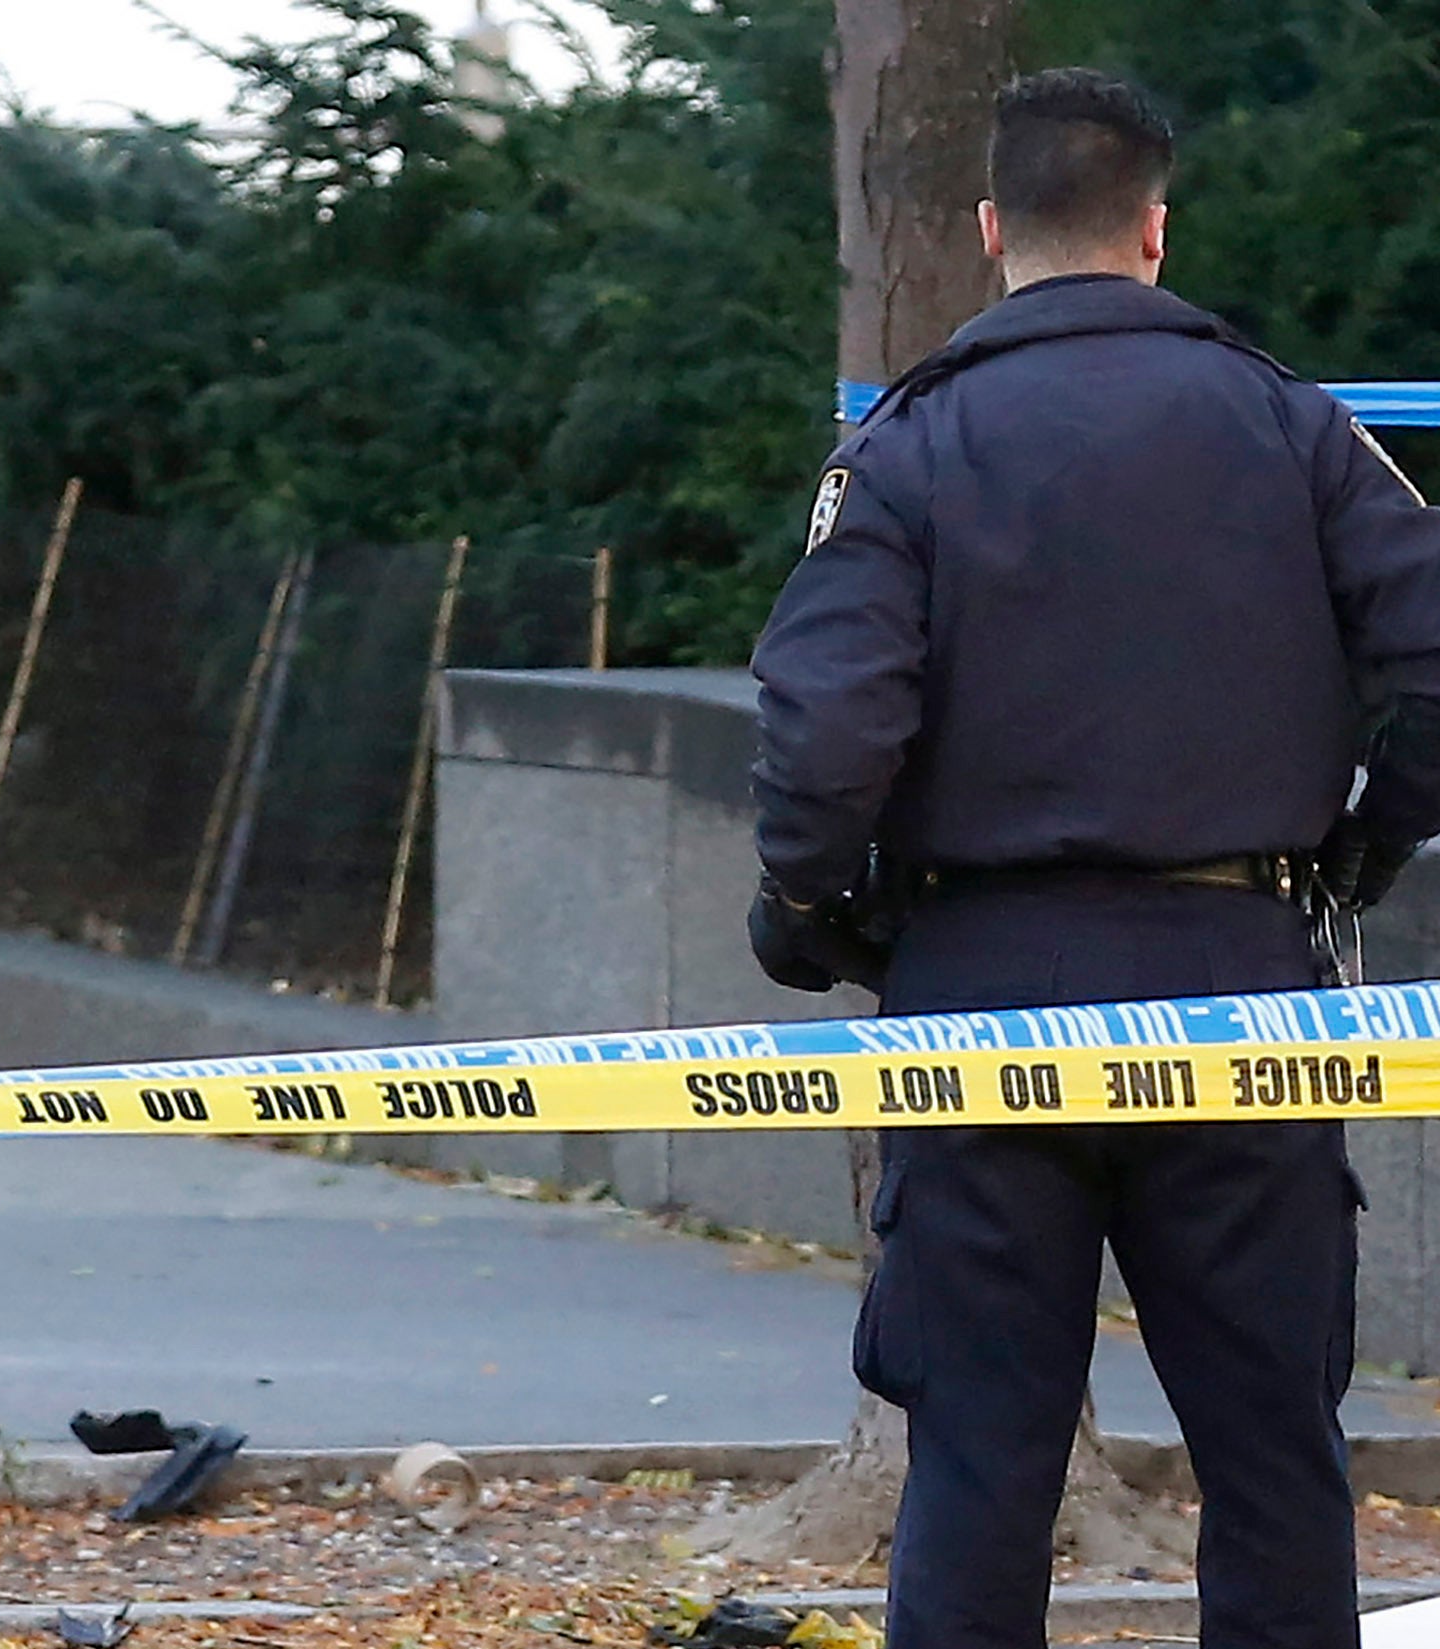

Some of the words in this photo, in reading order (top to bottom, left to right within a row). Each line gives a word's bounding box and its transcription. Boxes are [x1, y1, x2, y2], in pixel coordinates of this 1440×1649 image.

[1216, 990, 1331, 1044] LINE
[139, 1087, 209, 1122] DO
[244, 1083, 348, 1121] LINE
[375, 1077, 538, 1120] POLICE
[685, 1069, 841, 1117] CROSS
[877, 1066, 966, 1114] NOT
[999, 1063, 1063, 1112] DO
[1101, 1060, 1197, 1110] LINE
[1229, 1054, 1383, 1107] POLICE
[15, 1090, 110, 1124] NOT
